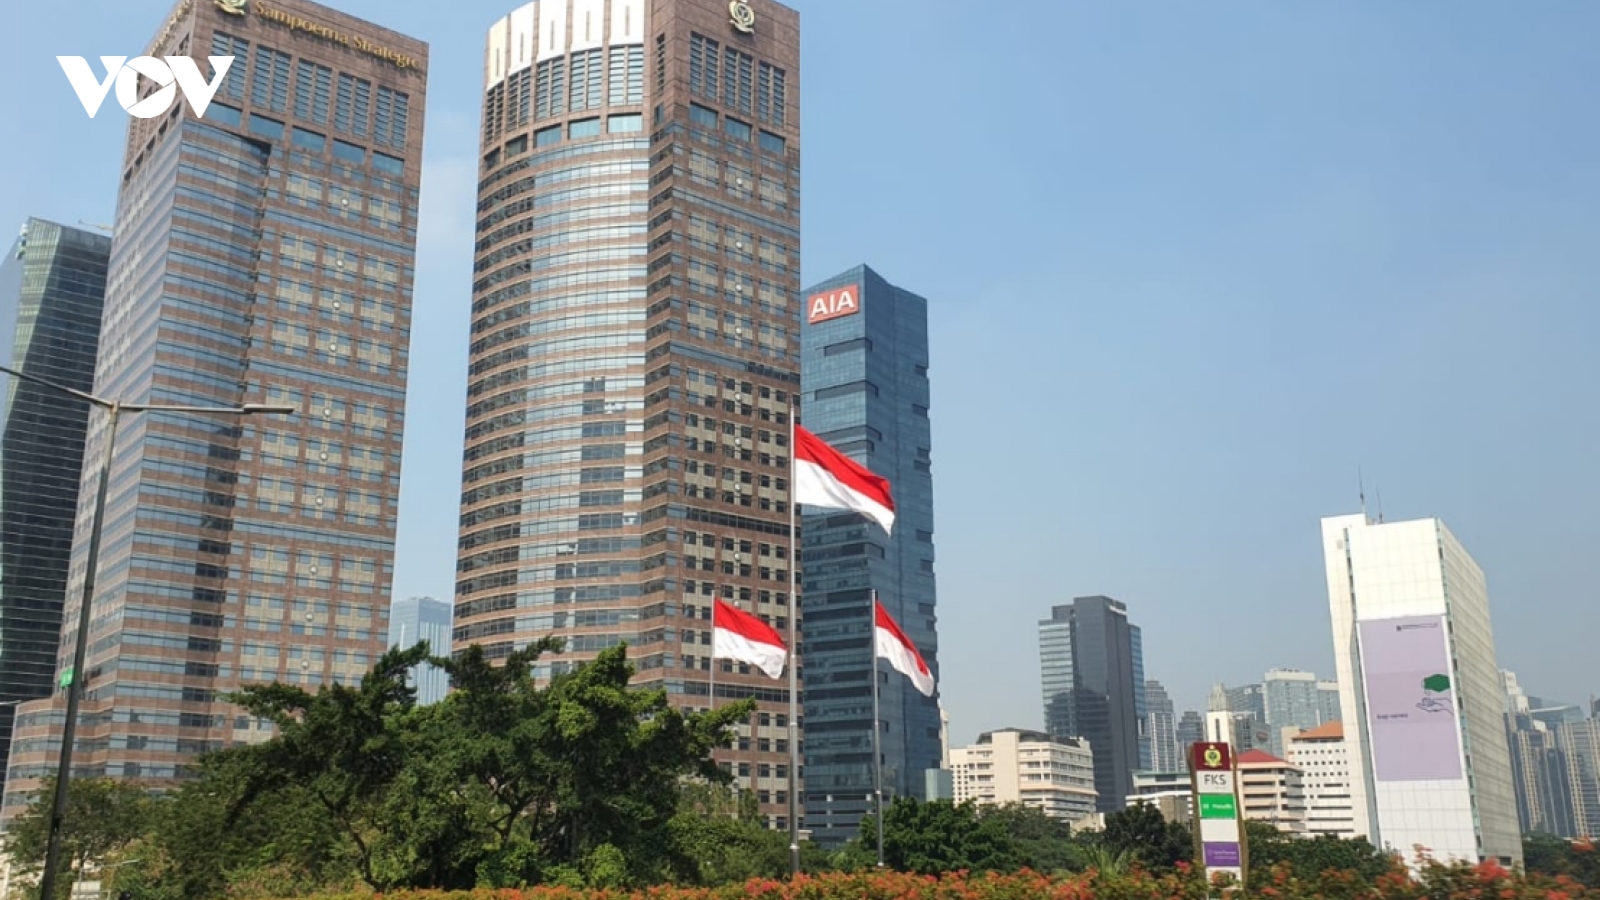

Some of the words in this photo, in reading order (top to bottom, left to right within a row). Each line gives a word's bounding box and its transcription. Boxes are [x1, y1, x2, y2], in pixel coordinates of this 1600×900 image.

[255, 1, 349, 44] Sampoerna
[353, 36, 420, 68] Strategic
[810, 290, 856, 318] AIA
[1203, 774, 1227, 785] FKS
